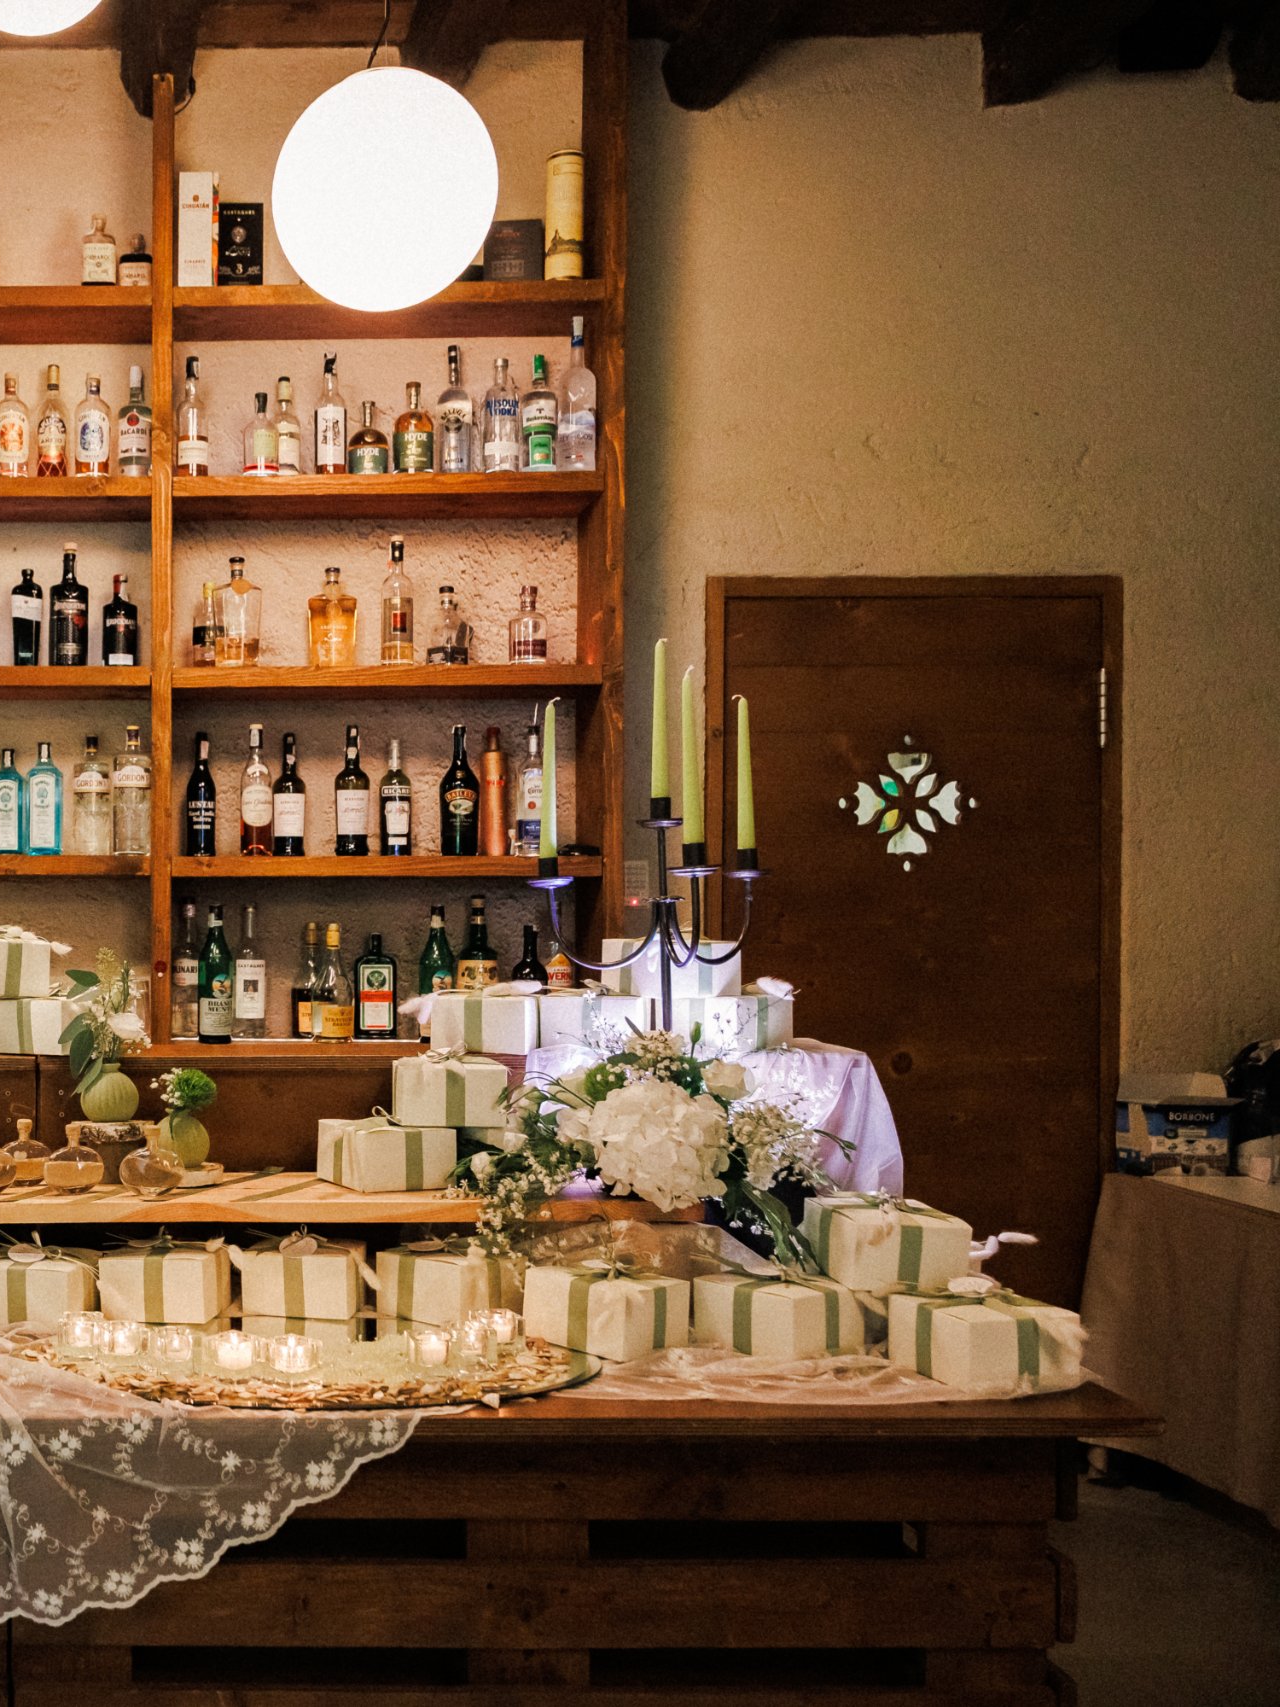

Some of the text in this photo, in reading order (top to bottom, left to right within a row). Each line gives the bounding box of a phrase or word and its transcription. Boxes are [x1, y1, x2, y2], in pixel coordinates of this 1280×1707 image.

[405, 432, 428, 441] HYDE
[357, 448, 380, 456] HYDE
[548, 972, 570, 981] VERN
[1168, 1111, 1215, 1122] BORBONE
